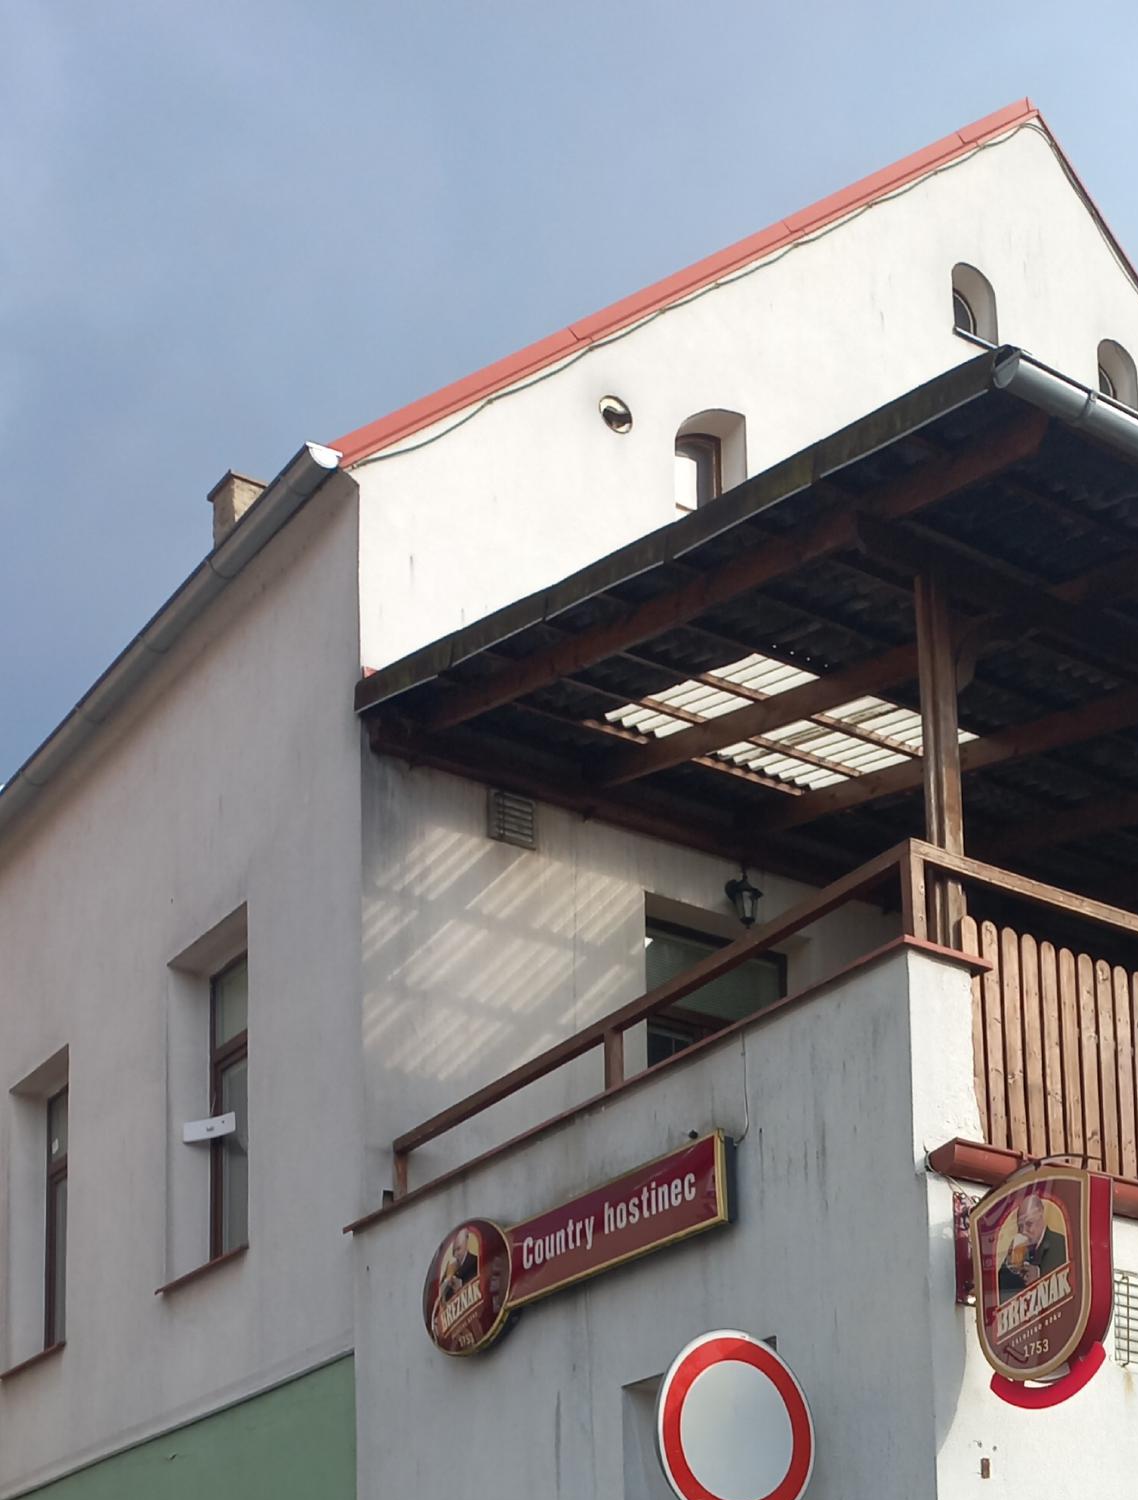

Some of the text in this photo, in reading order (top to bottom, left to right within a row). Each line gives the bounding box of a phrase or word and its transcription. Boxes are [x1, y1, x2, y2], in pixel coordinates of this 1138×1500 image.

[522, 1172, 697, 1270] Country hostinec
[1023, 1338, 1049, 1358] 1753
